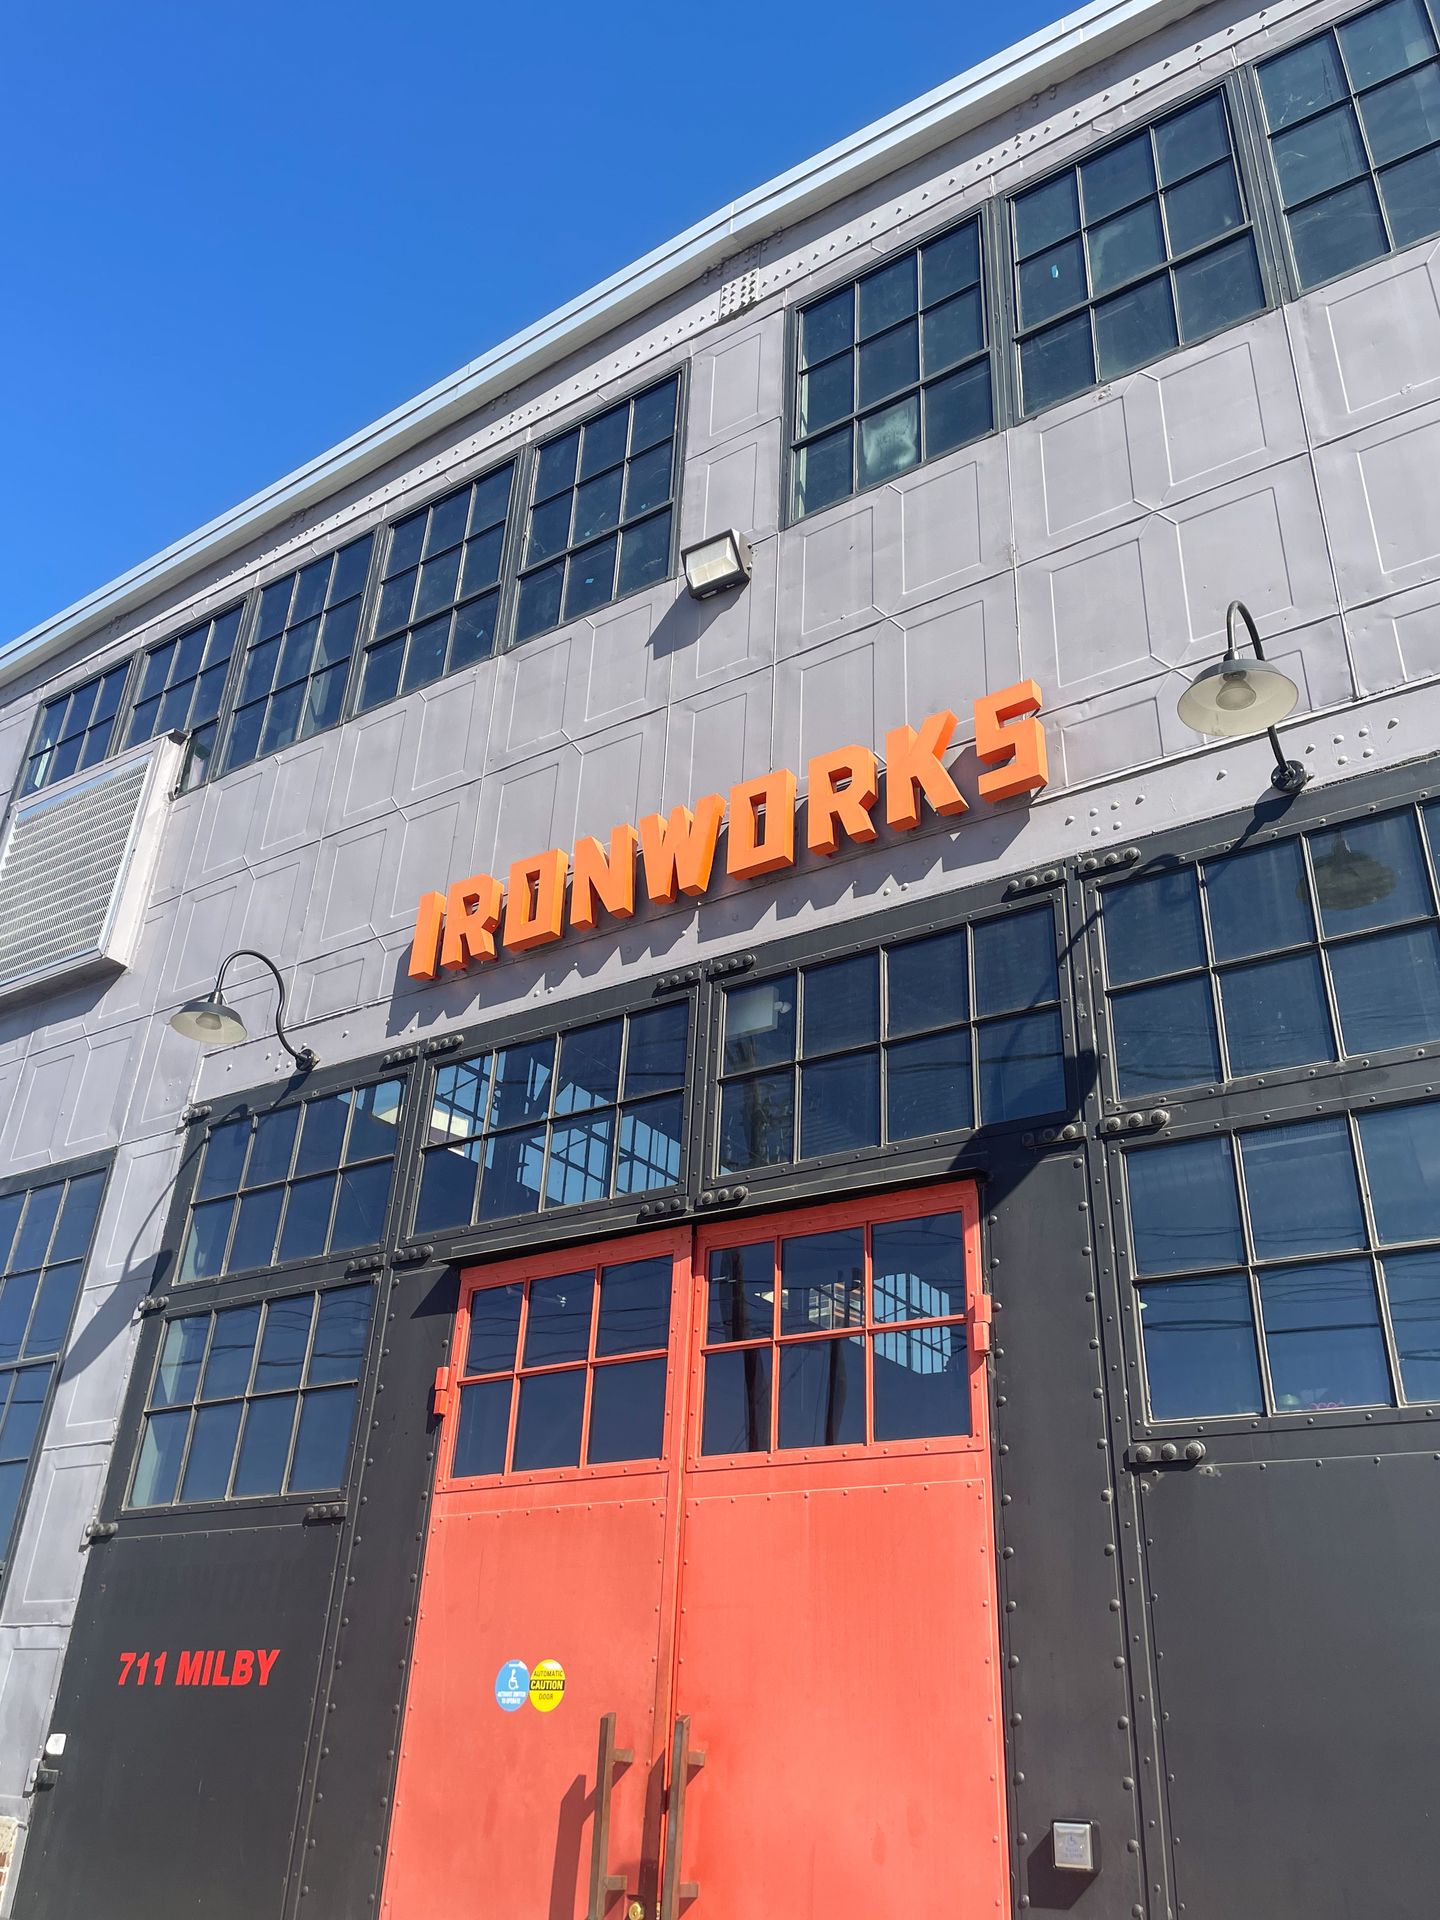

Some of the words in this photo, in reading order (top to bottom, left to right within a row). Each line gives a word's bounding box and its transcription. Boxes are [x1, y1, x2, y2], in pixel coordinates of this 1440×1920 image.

[409, 680, 1049, 981] IRONWORKS
[118, 1651, 168, 1686] 711
[175, 1649, 281, 1686] MILBY
[530, 1680, 563, 1690] CAUTION
